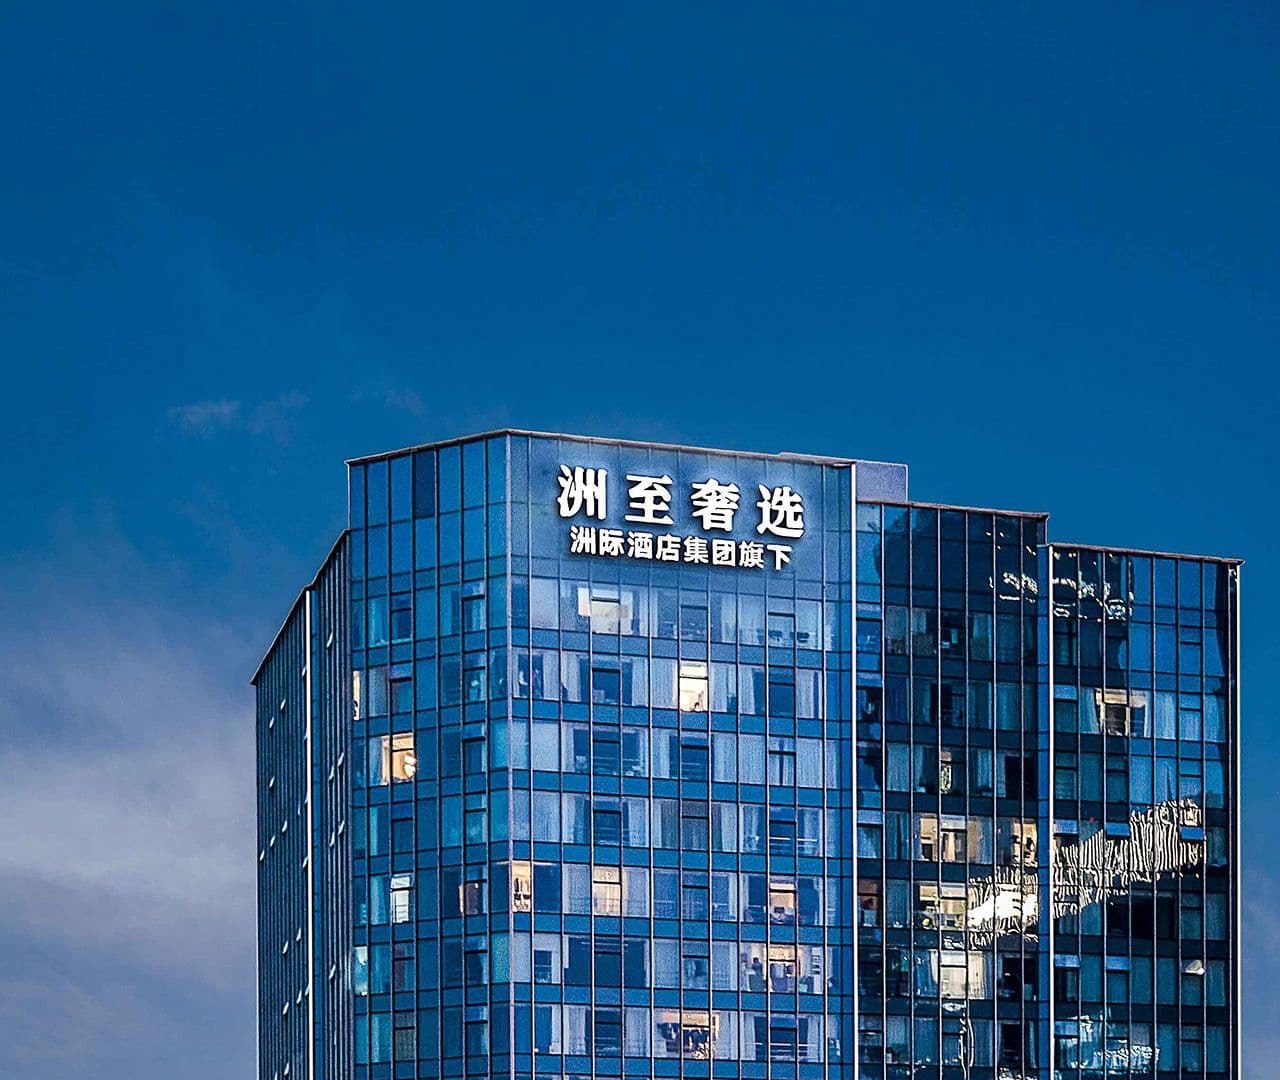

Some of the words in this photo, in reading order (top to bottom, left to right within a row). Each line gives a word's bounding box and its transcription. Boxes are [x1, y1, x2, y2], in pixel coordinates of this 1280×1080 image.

[557, 464, 805, 538] 洲至奢选
[570, 525, 793, 571] 洲际酒店集团旗下
